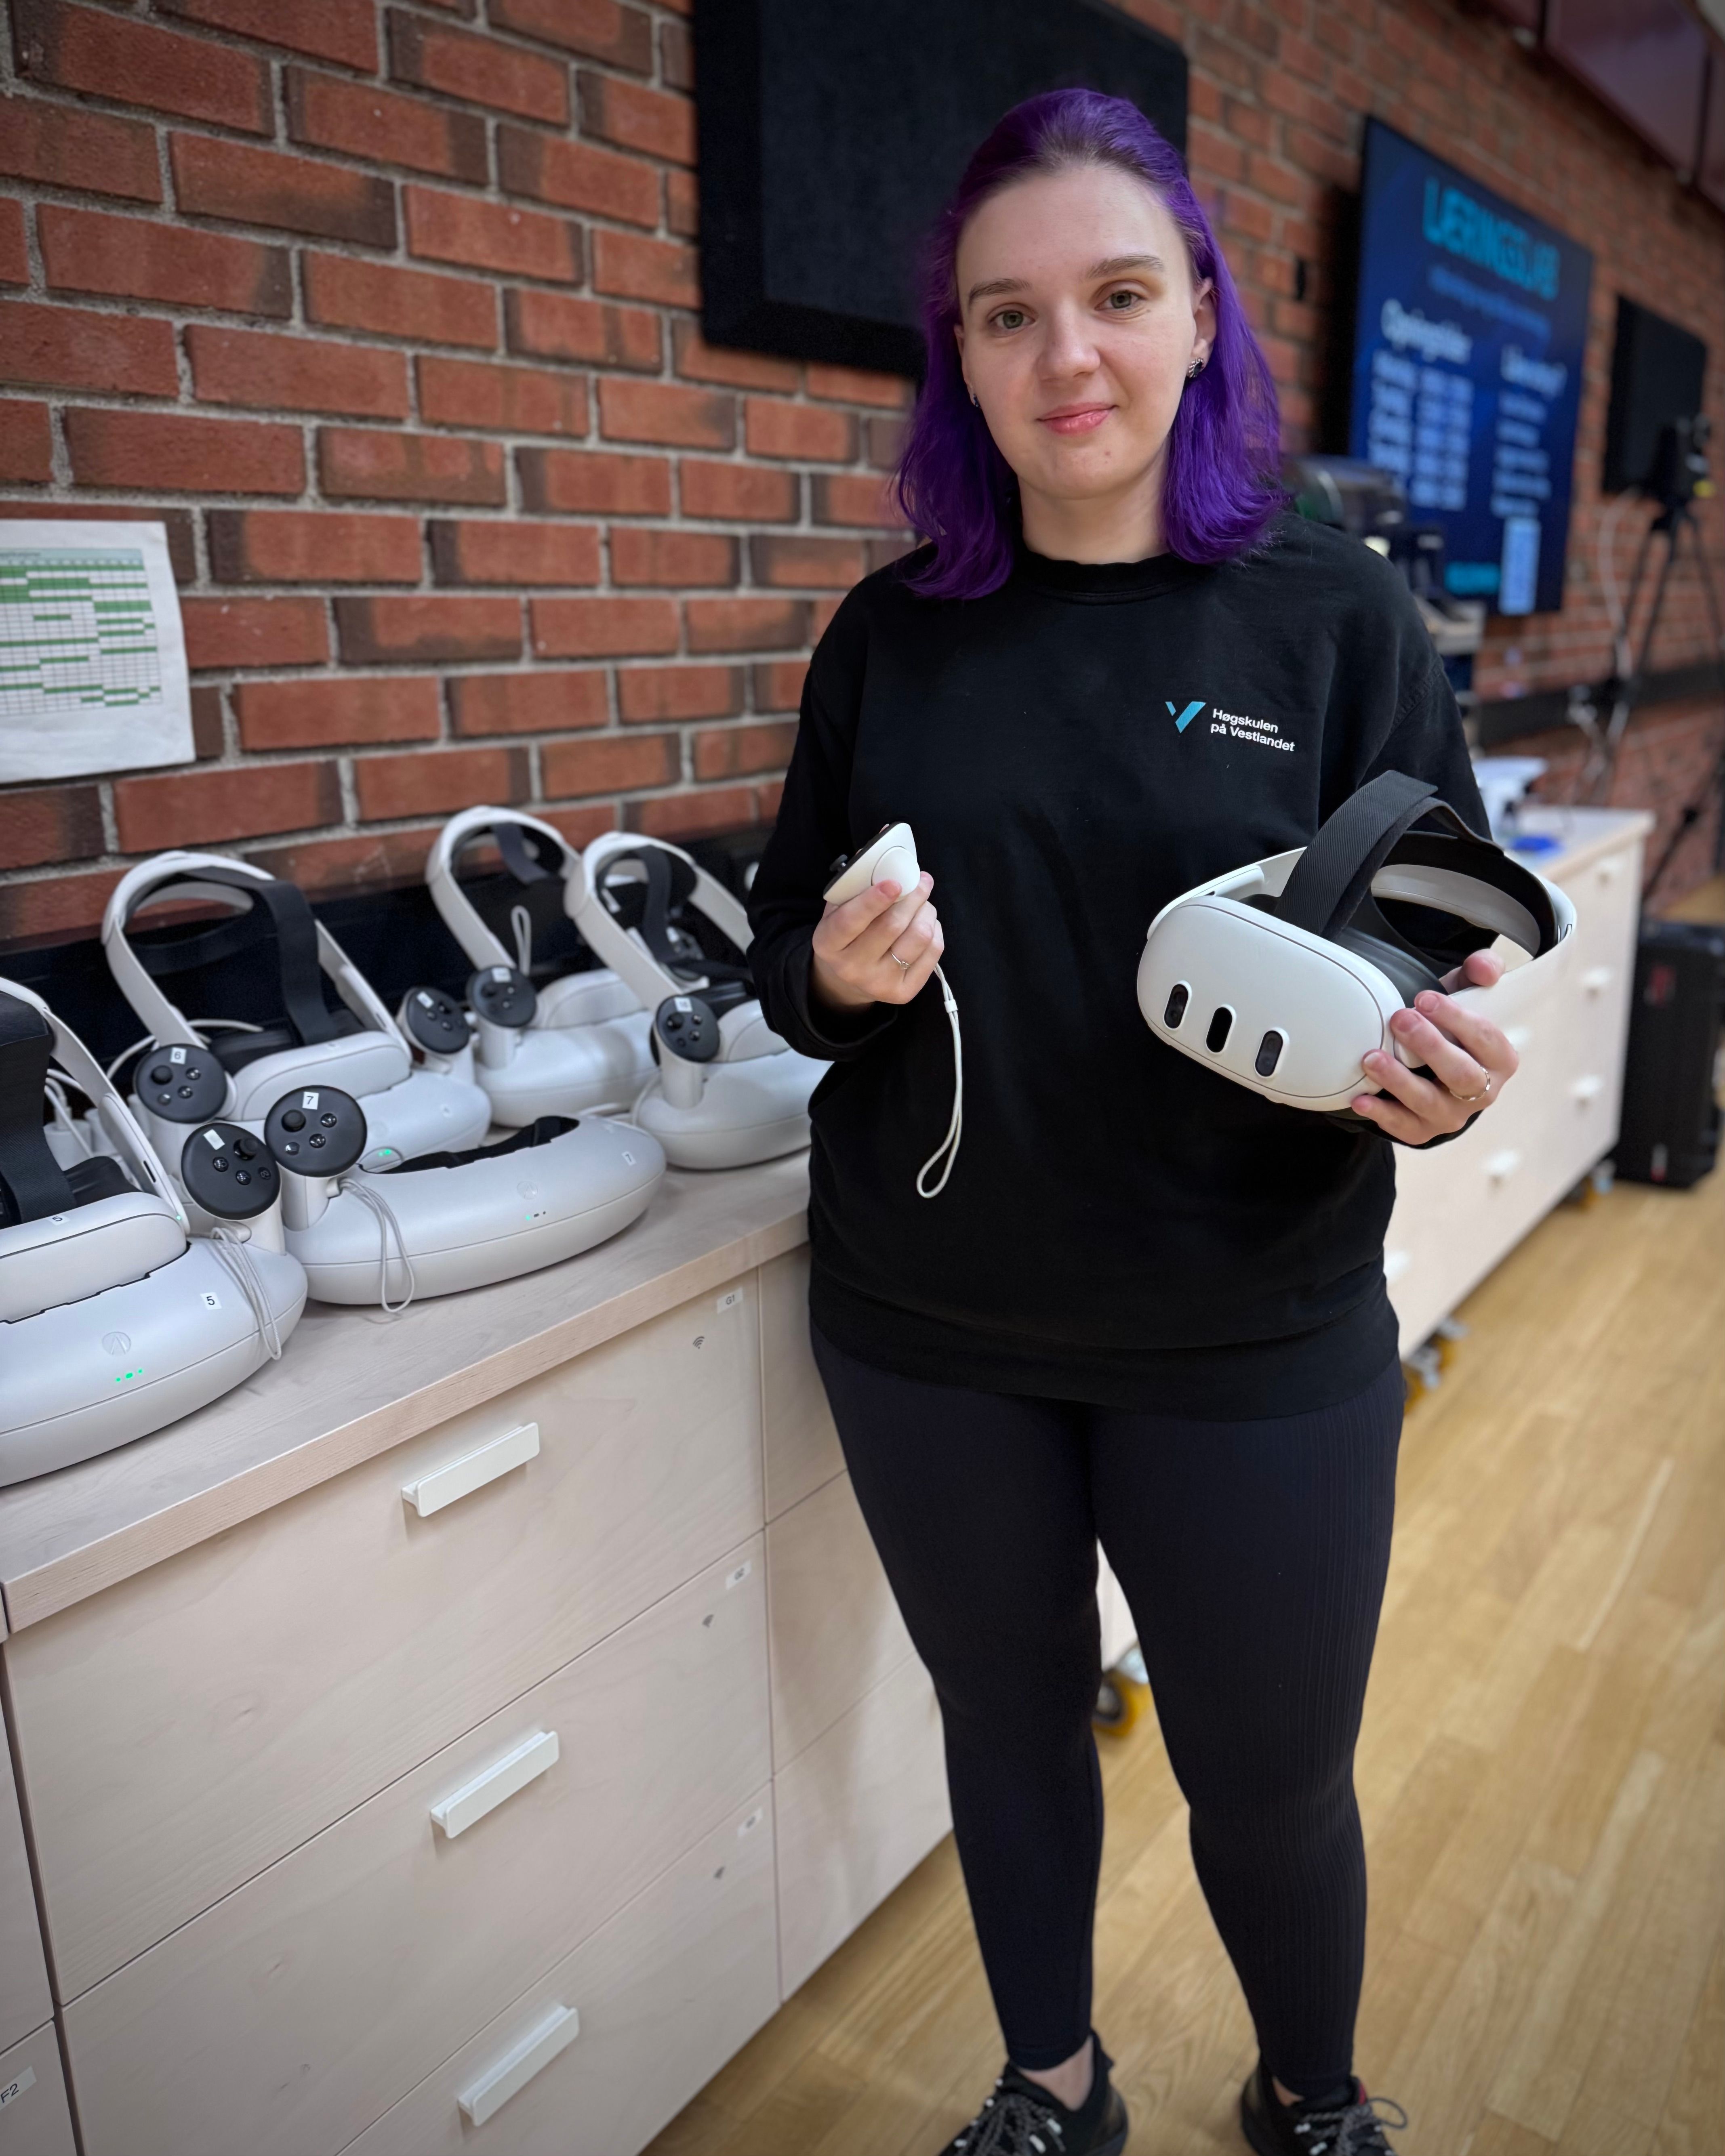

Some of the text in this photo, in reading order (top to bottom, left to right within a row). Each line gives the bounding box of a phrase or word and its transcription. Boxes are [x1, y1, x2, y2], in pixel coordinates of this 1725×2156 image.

[1212, 708, 1278, 733] Høgskulen
[1210, 723, 1295, 752] på Vestlandet
[174, 1051, 181, 1060] 6
[307, 1096, 314, 1105] 7
[206, 1296, 215, 1305] 5
[726, 1294, 735, 1305] G1
[0, 2083, 19, 2103] F2
